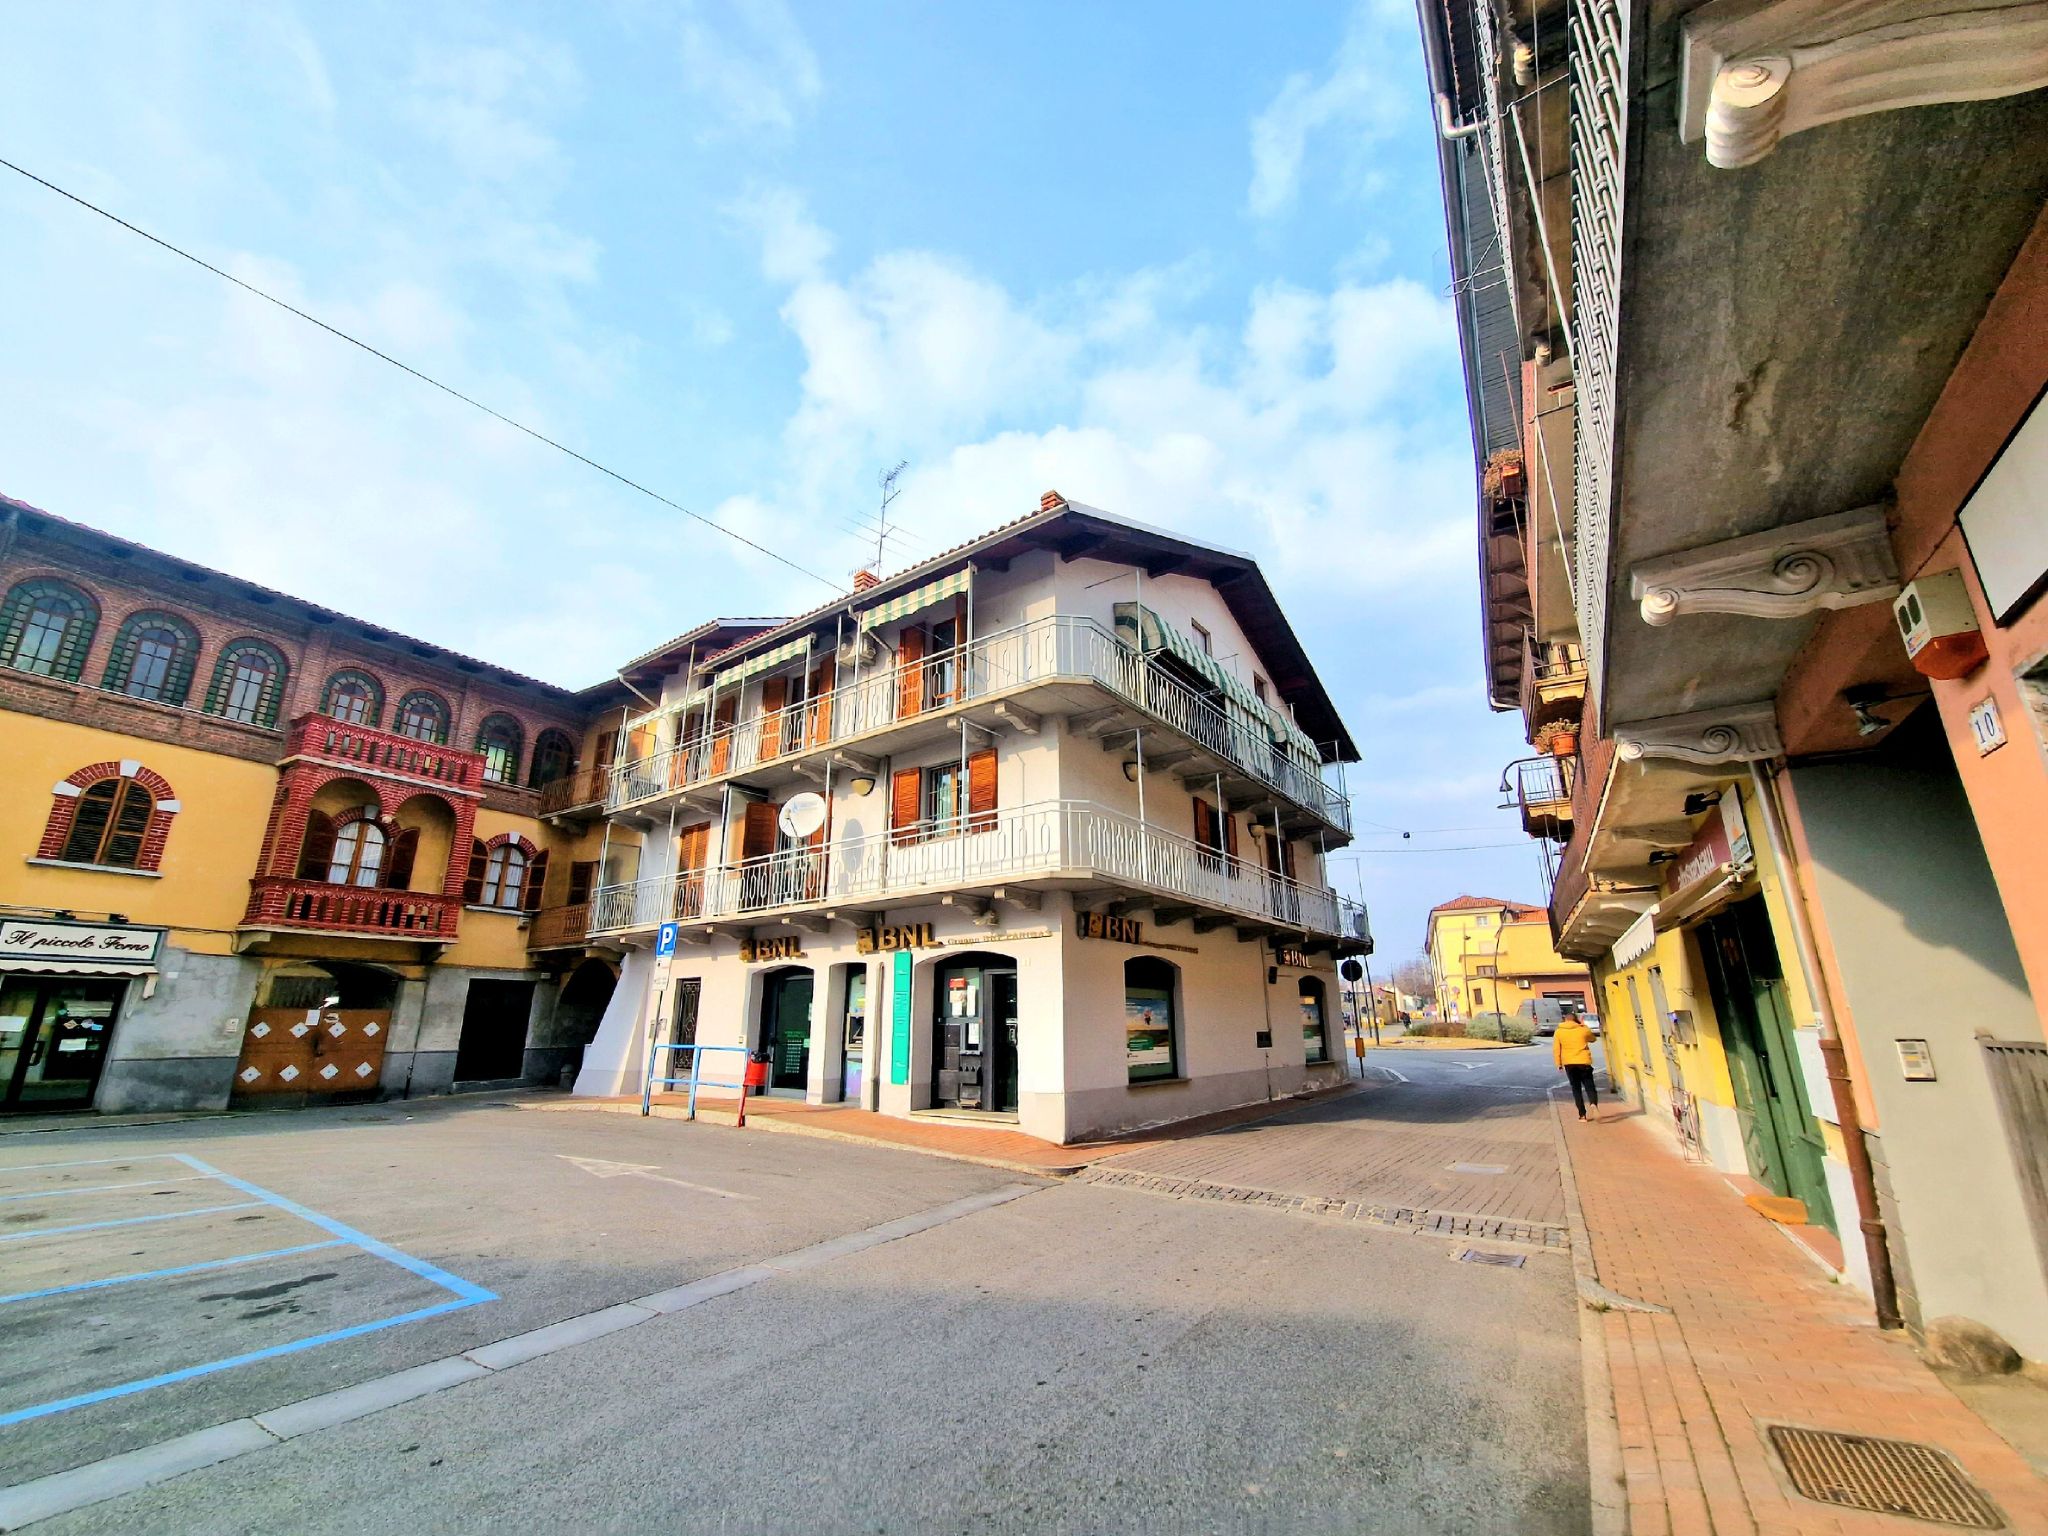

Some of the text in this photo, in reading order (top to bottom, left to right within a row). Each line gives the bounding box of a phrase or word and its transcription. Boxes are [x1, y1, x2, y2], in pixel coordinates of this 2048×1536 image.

[1975, 712, 1995, 744] 10
[5, 929, 150, 951] Il piccolo Forno
[660, 927, 674, 952] P
[756, 936, 802, 960] BNL
[878, 922, 944, 951] BNL
[1291, 950, 1313, 968] BNL
